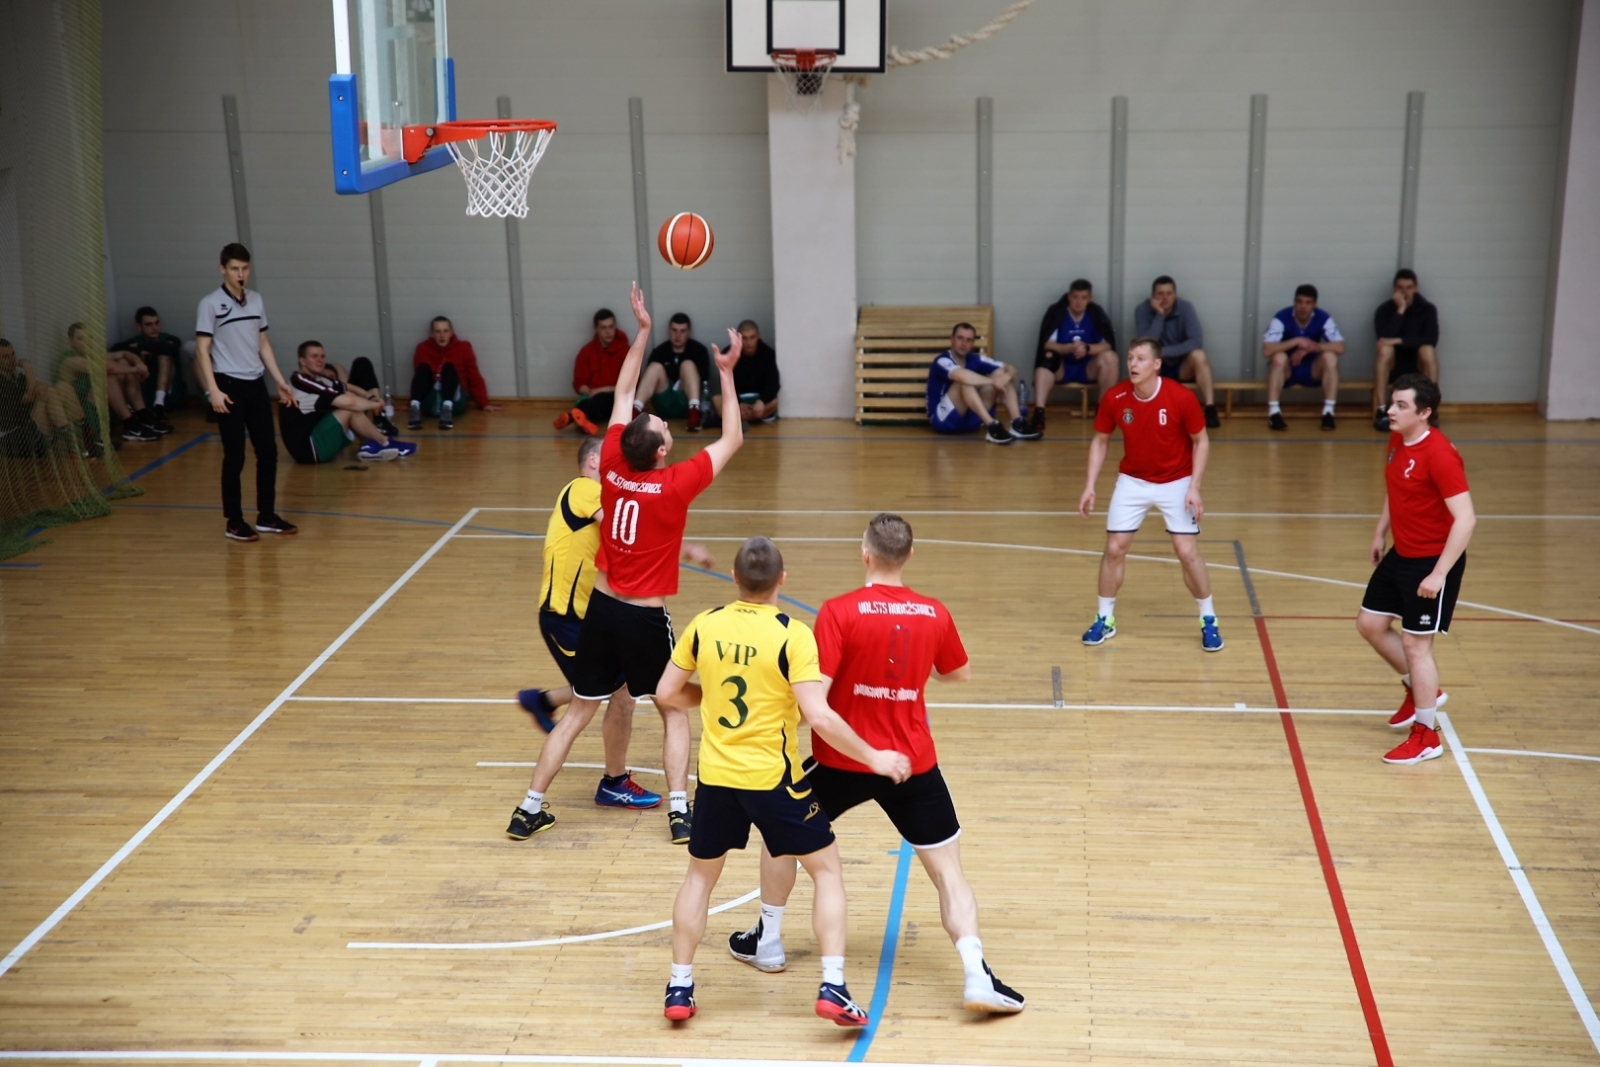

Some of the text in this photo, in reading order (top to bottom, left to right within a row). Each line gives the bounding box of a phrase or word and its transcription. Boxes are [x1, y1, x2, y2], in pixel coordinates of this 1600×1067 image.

[1158, 408, 1168, 426] 6
[1404, 458, 1416, 479] 2
[611, 497, 640, 546] 10
[714, 640, 758, 667] VIP
[717, 675, 749, 730] 3
